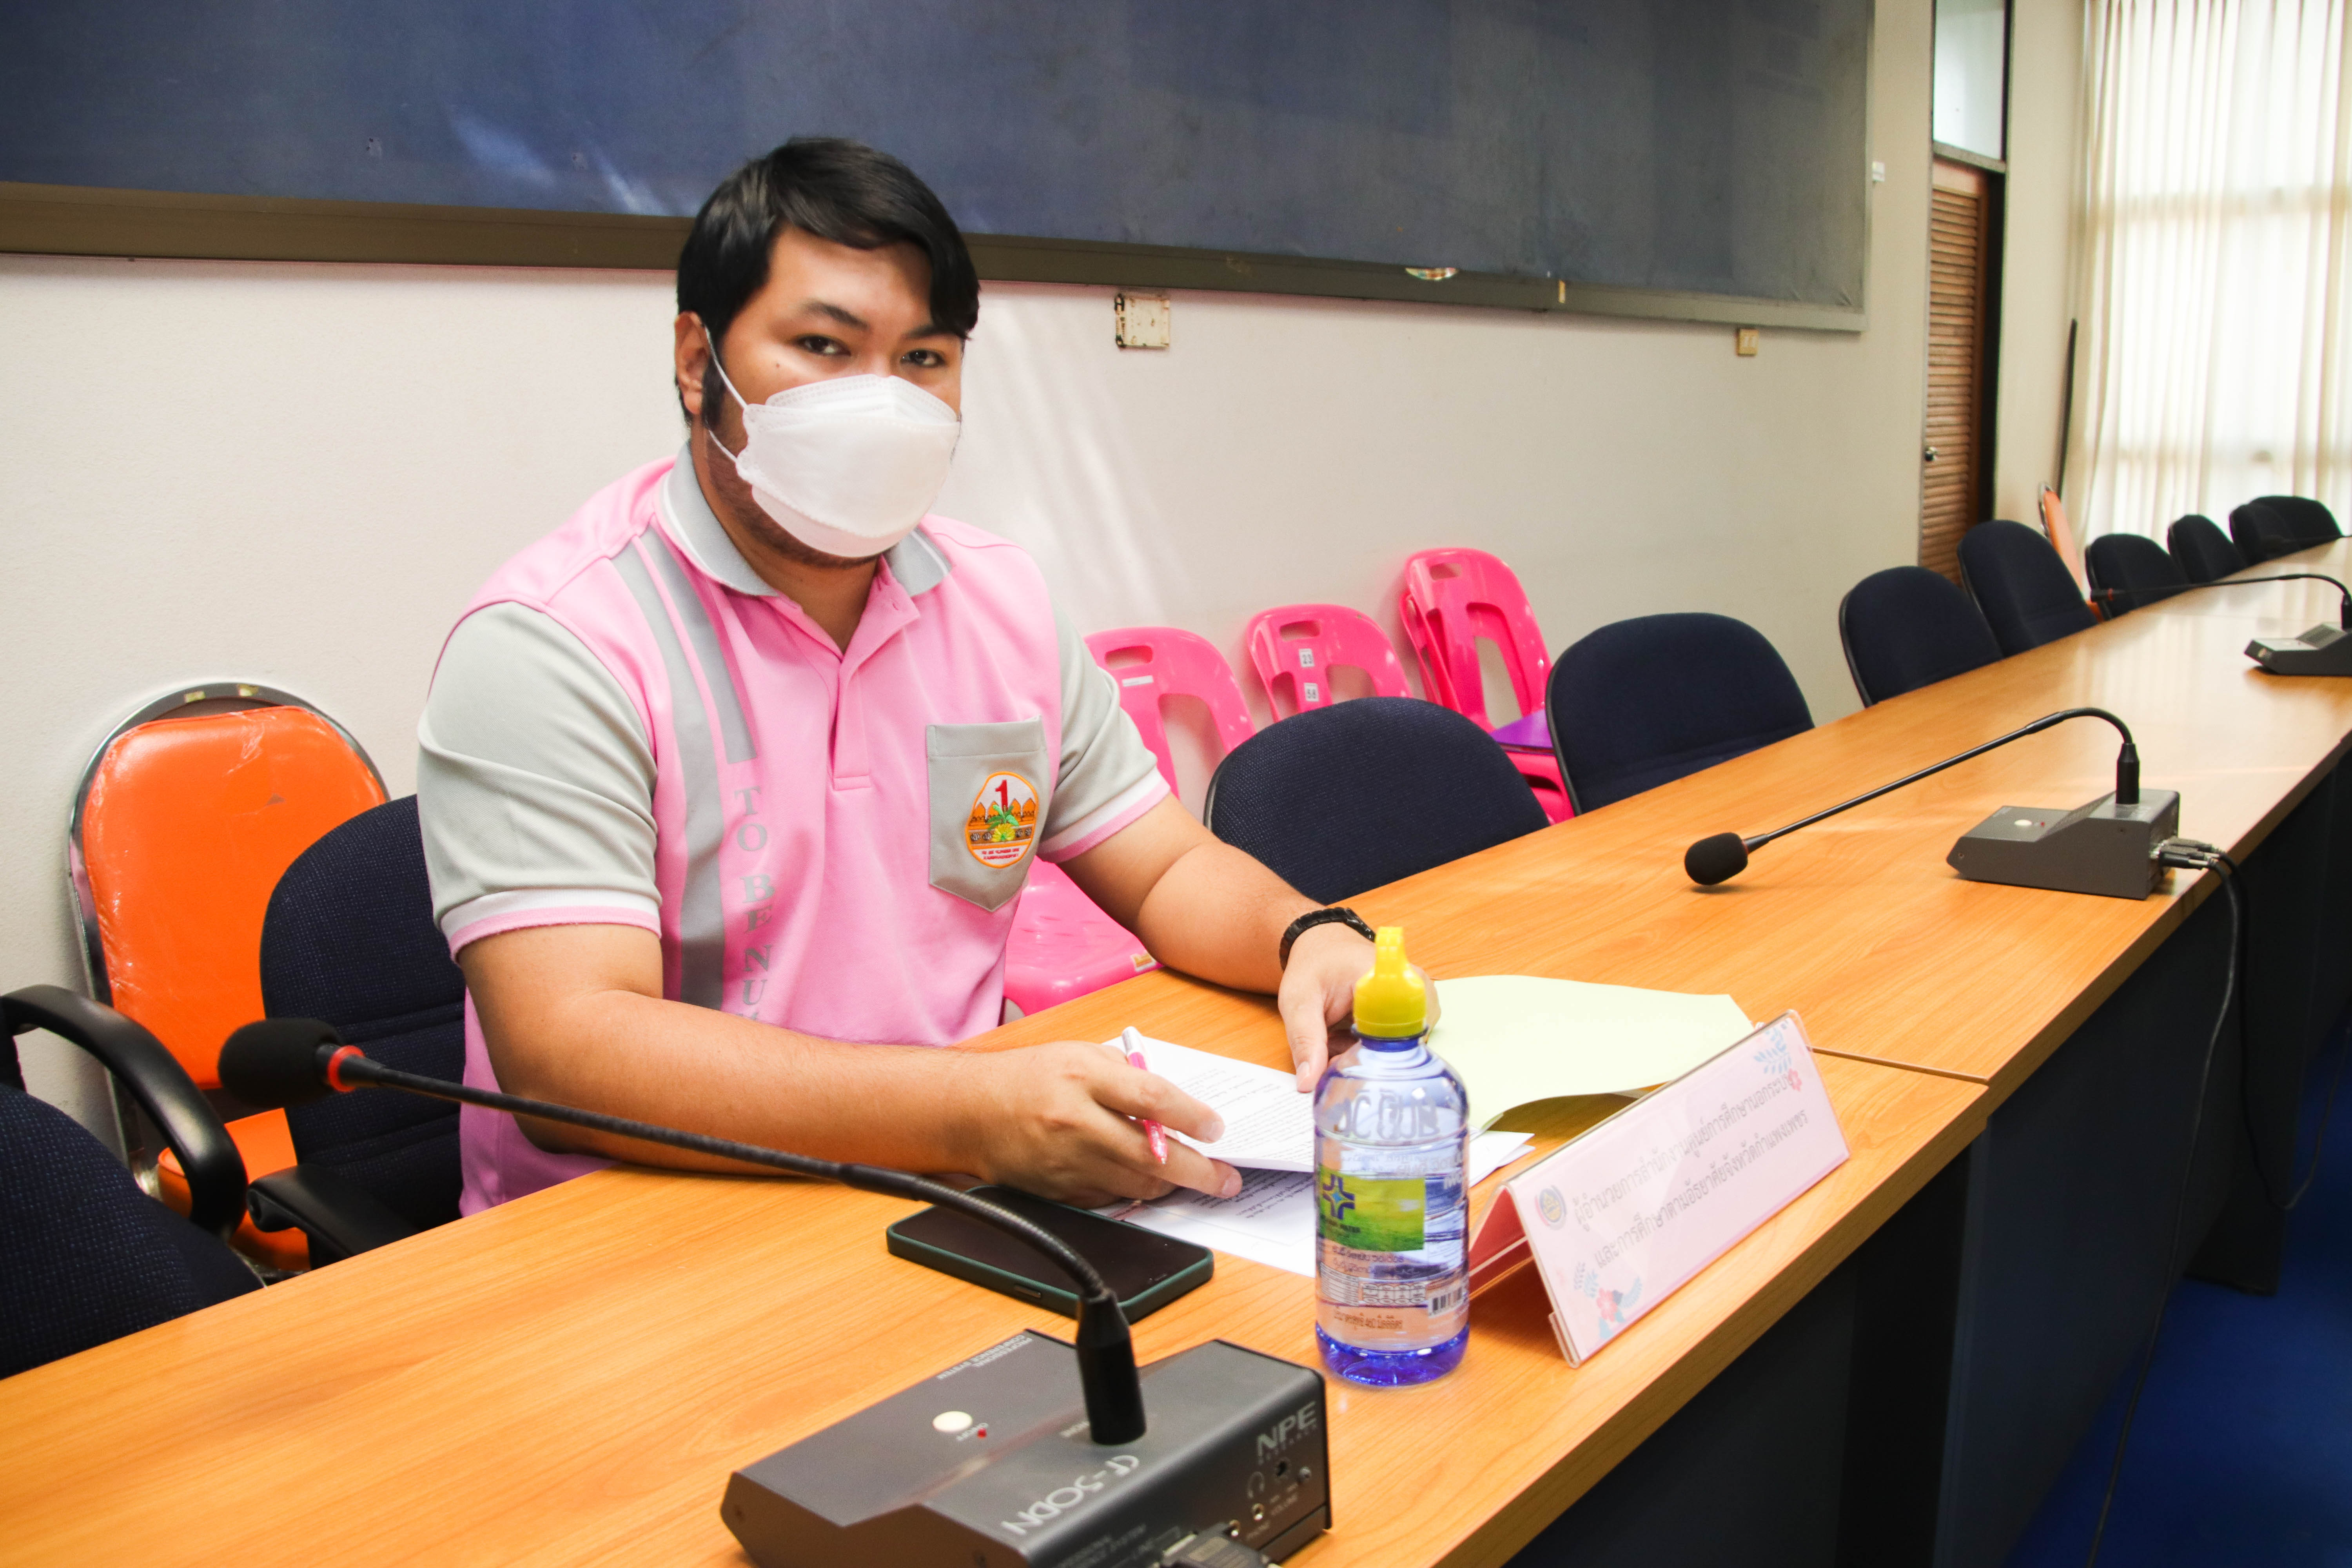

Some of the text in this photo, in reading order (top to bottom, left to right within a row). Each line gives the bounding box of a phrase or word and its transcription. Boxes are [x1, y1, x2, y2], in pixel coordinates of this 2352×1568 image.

[995, 780, 1008, 811] 1
[734, 785, 775, 1021] TO BE NU
[1257, 1401, 1317, 1457] NPE
